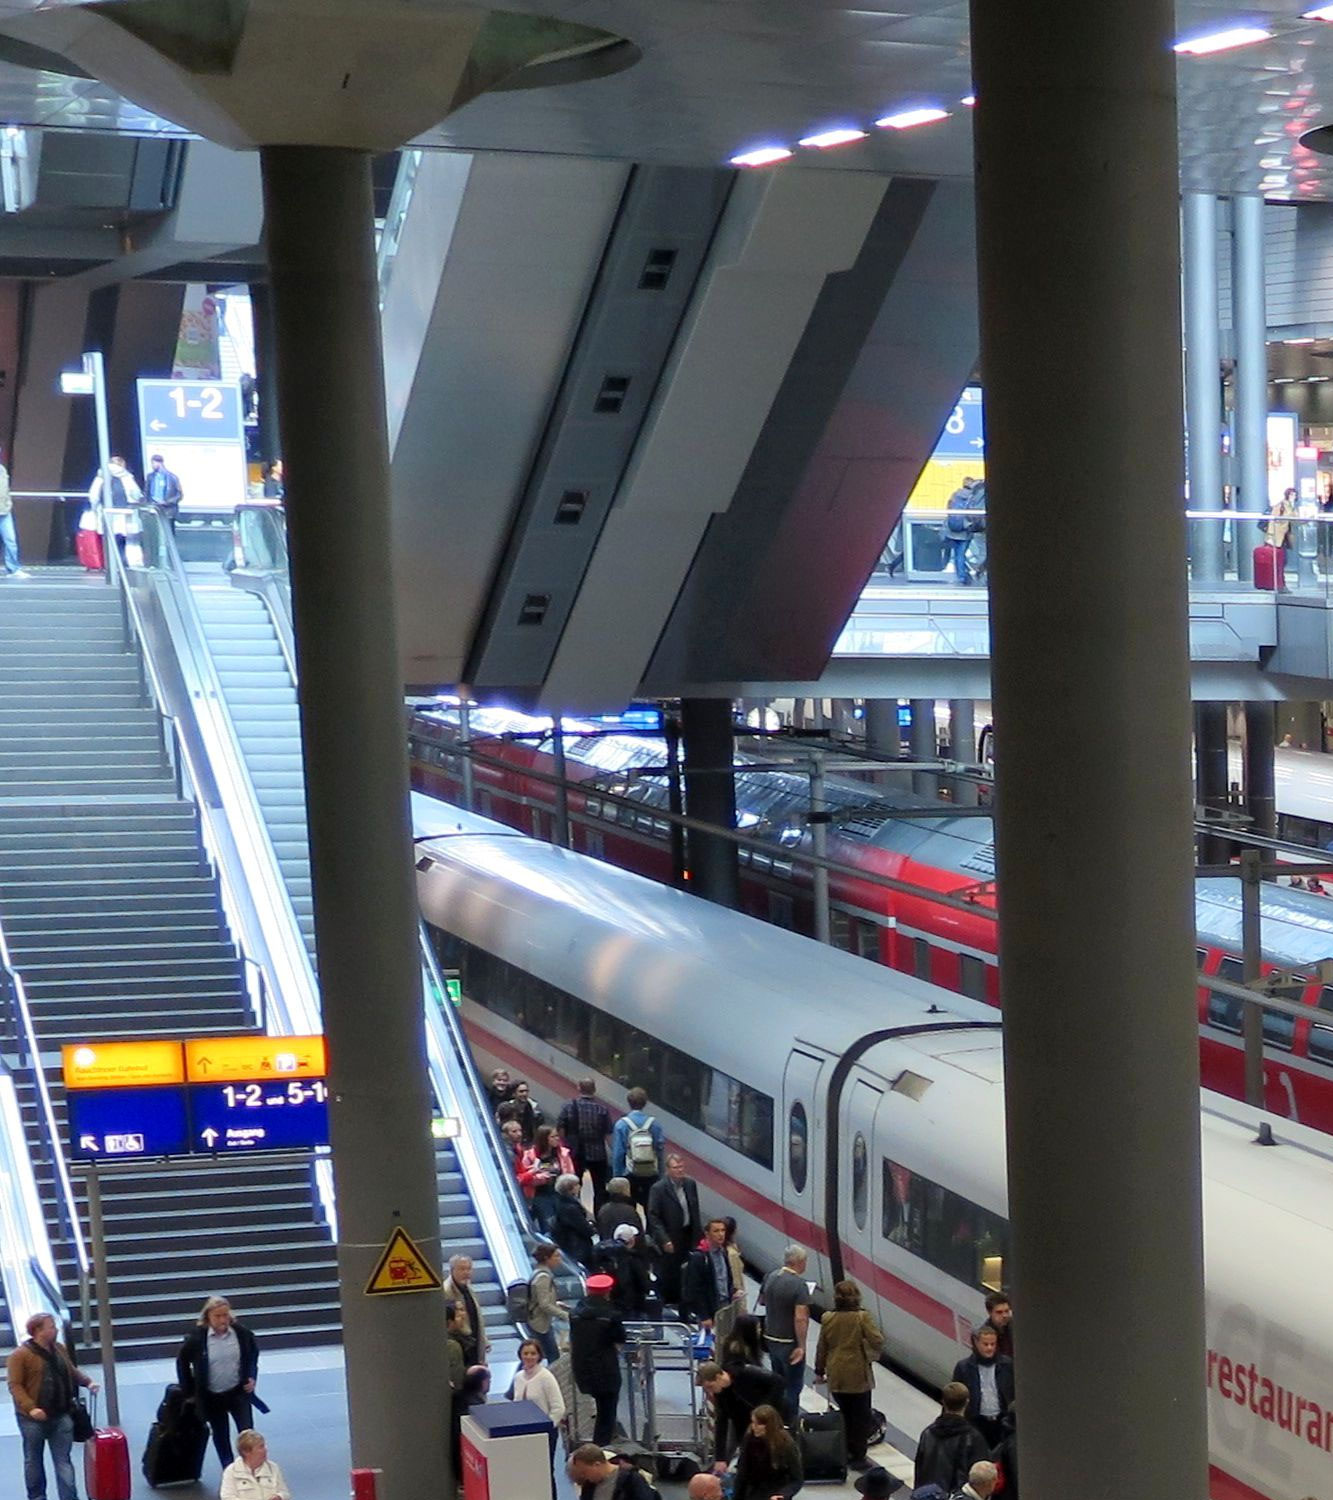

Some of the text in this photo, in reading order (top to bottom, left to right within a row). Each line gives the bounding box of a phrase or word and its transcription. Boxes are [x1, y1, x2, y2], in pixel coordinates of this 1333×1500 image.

[168, 386, 224, 419] 1-2
[222, 1084, 263, 1107] 1-2
[287, 1081, 328, 1104] 5-1
[225, 1127, 265, 1139] Ausgang
